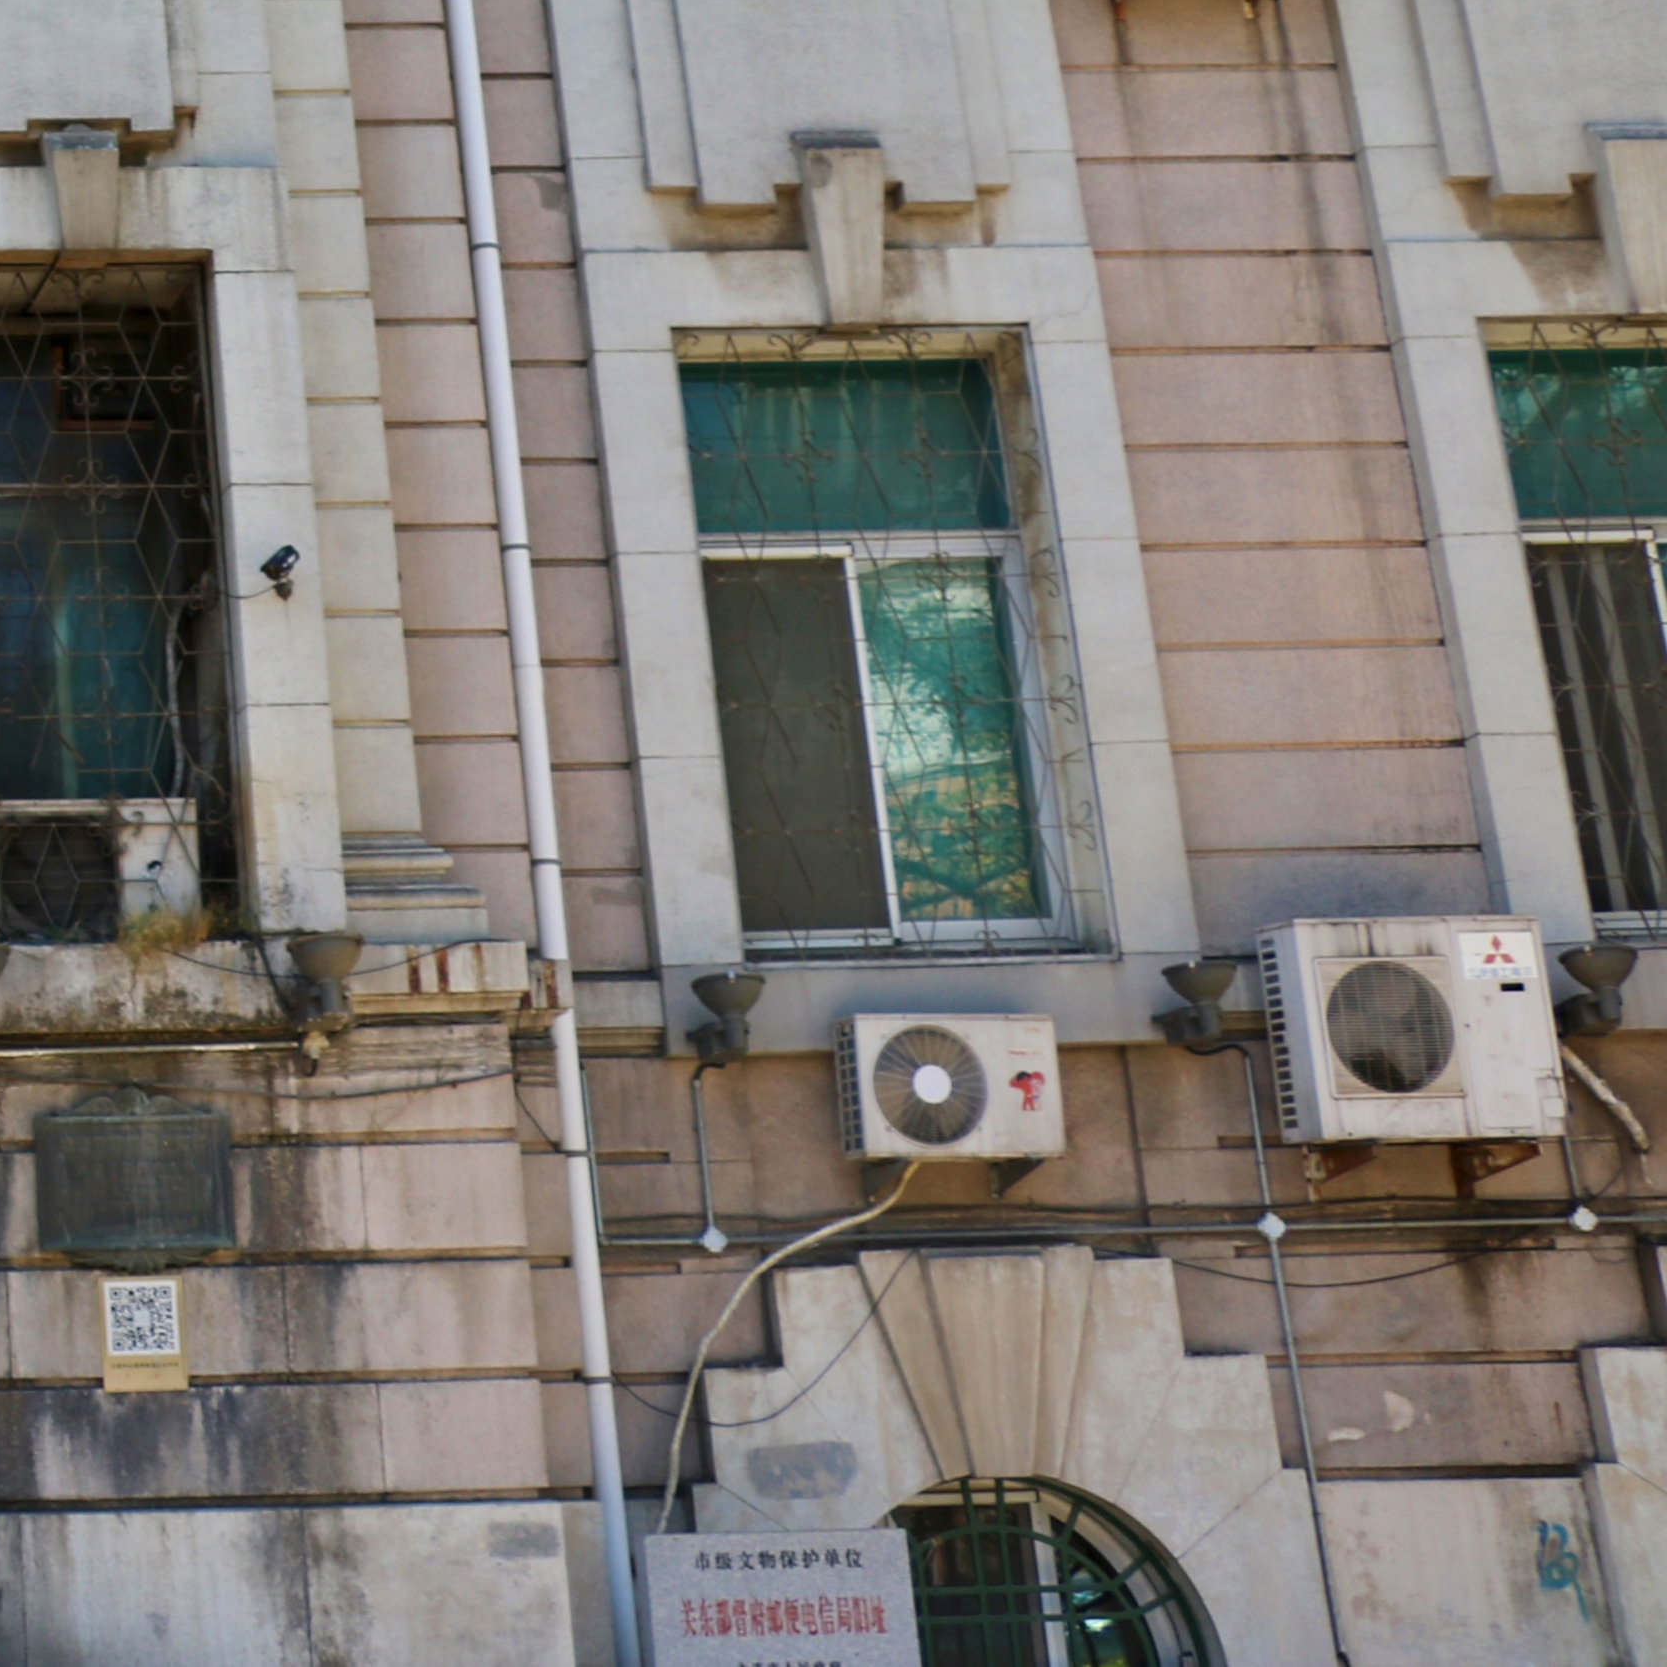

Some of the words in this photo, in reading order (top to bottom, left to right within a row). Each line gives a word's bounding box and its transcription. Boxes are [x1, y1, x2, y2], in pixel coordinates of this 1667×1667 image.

[695, 1548, 863, 1571] 市级文物保护单位
[682, 1594, 887, 1636] 关东都督府邮便电信局旧址
